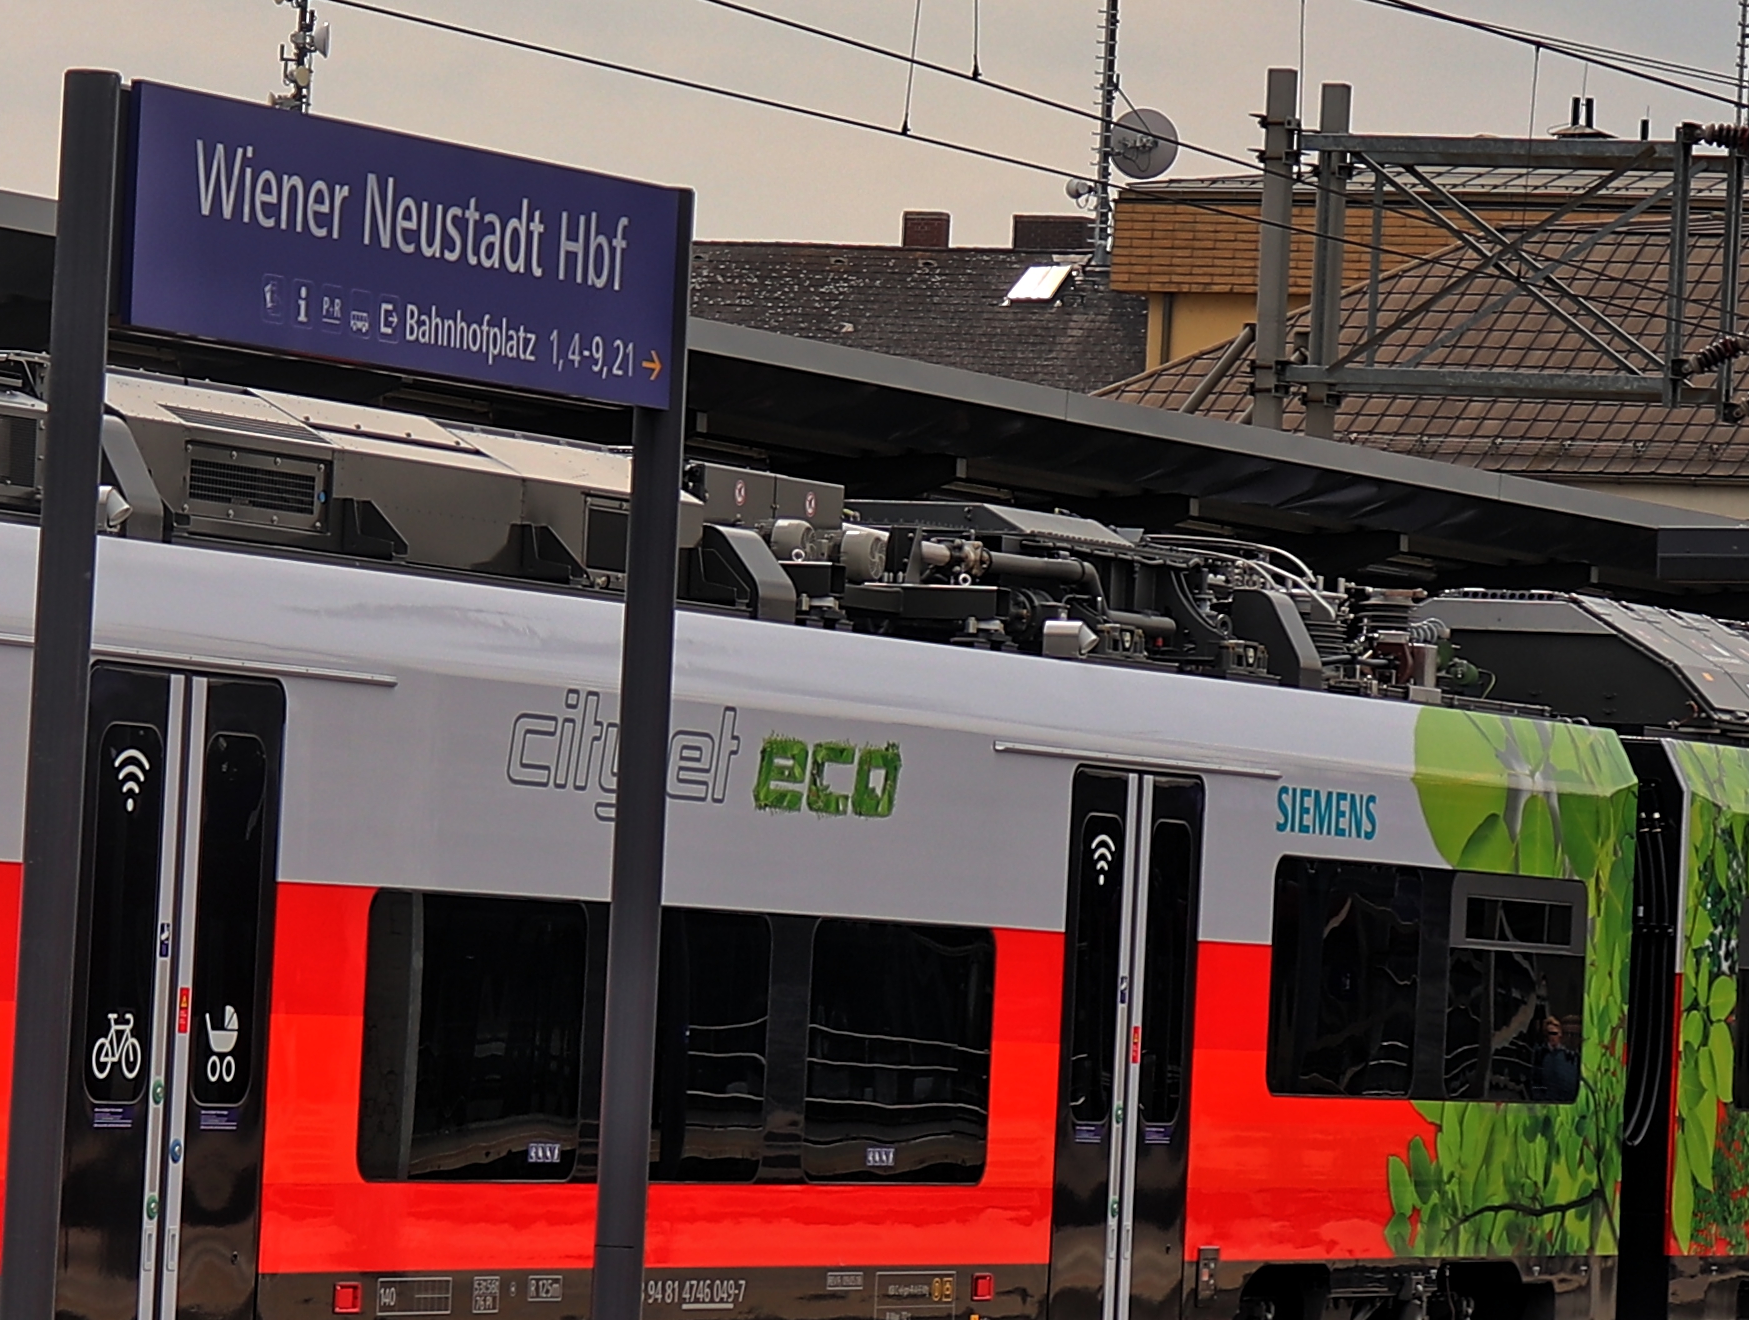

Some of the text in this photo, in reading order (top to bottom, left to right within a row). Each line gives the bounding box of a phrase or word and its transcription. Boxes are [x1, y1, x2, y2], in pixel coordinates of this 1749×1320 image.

[195, 138, 630, 292] Wiener Neustadt Hbf
[404, 302, 537, 366] Bahnhofplatz
[506, 688, 903, 822] citet eco
[1276, 784, 1377, 841] SIEMENS
[380, 1287, 396, 1306] 140
[530, 1280, 560, 1297] R 125m
[647, 1280, 746, 1304] 94 81 4746 049-7
